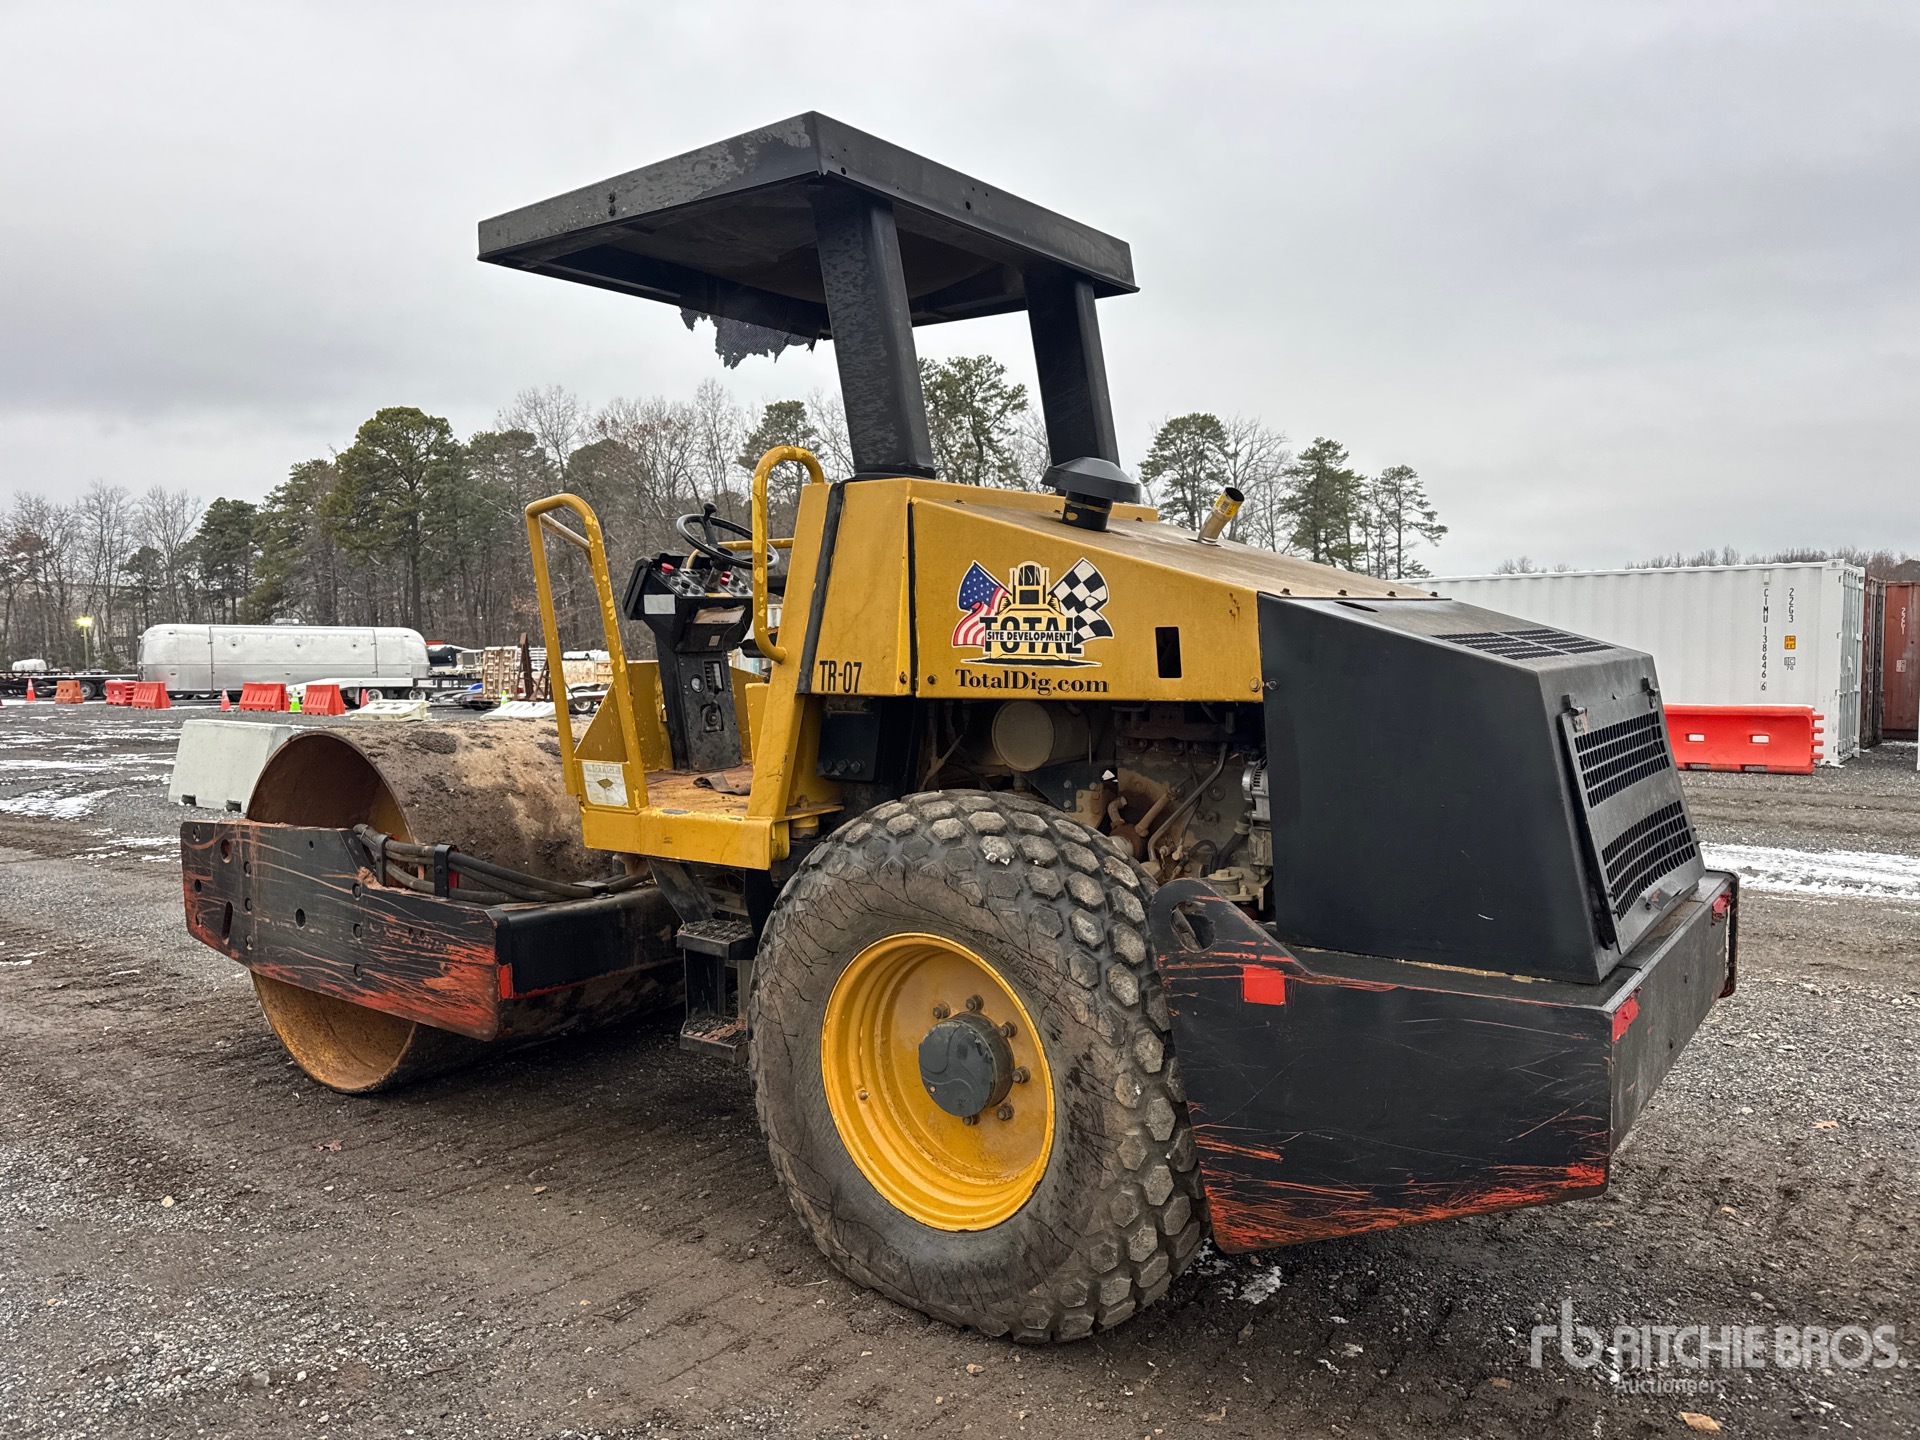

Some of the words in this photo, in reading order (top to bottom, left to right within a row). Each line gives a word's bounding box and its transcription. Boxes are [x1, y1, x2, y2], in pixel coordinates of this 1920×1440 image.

[980, 616, 1082, 654] TOTAL
[986, 631, 1005, 641] SITE
[1007, 631, 1072, 642] DEVELOPMENT
[819, 660, 862, 694] TR-07
[955, 669, 1109, 696] TotalDig.com
